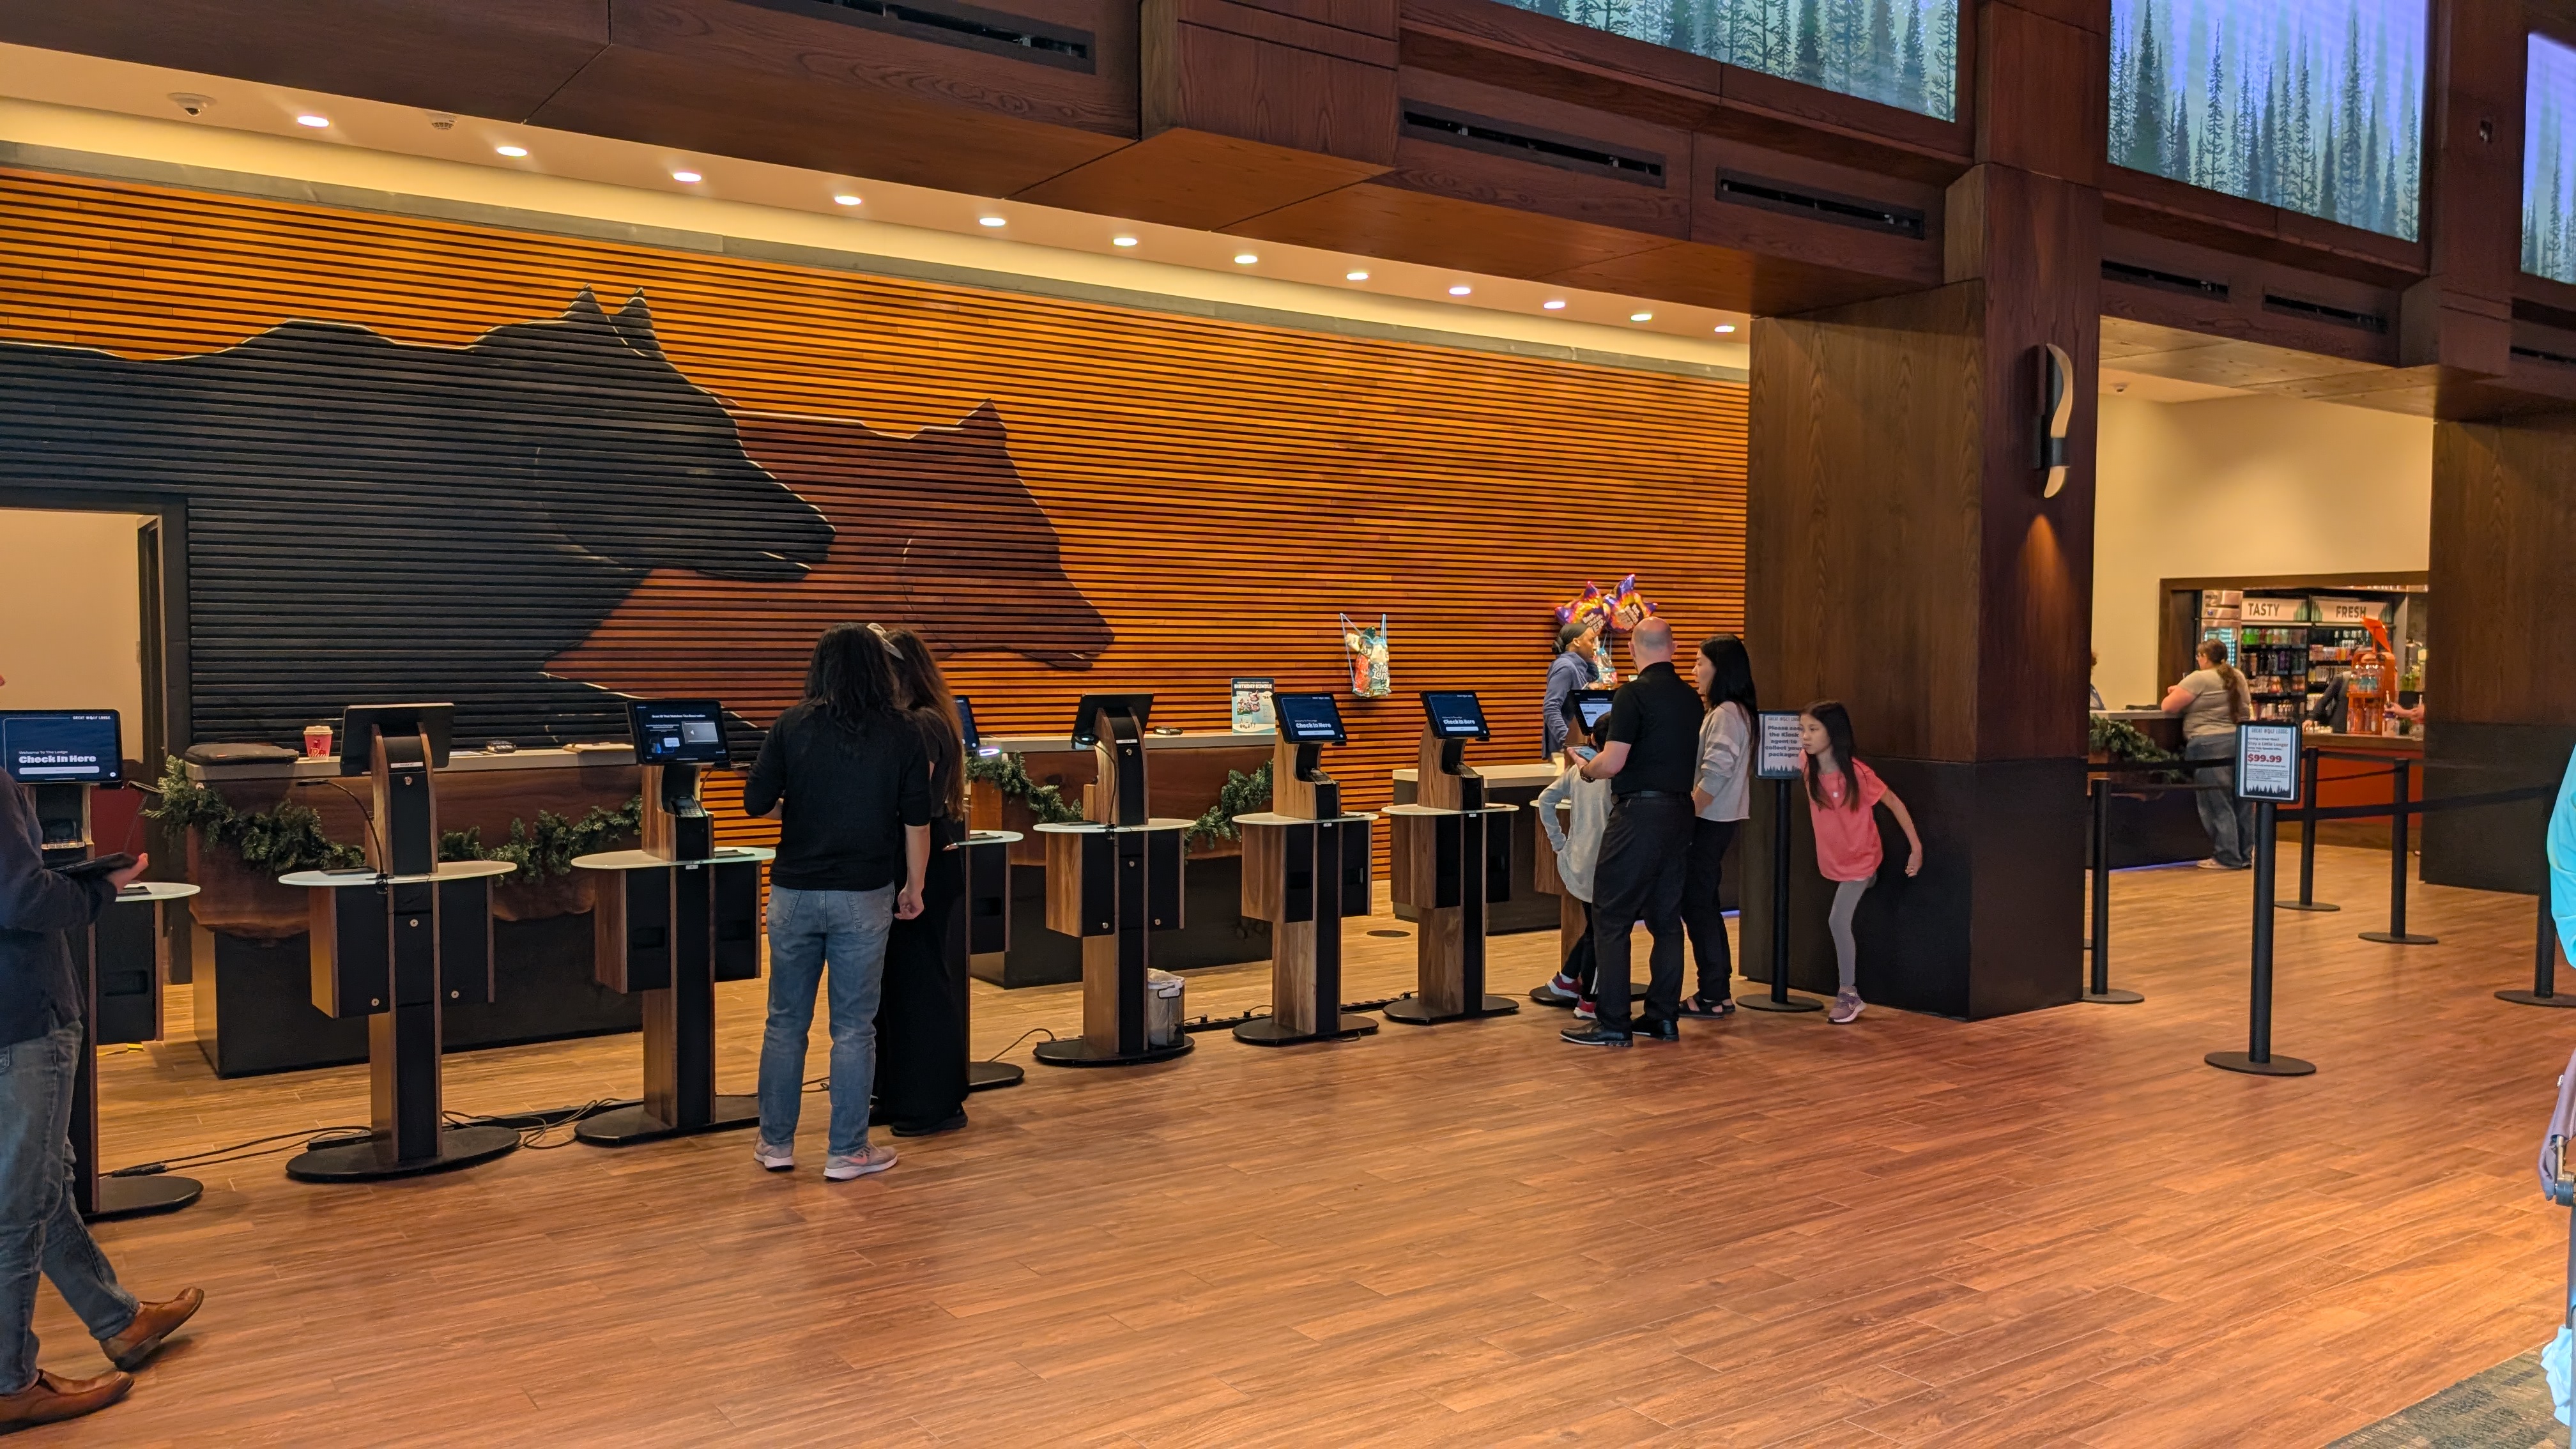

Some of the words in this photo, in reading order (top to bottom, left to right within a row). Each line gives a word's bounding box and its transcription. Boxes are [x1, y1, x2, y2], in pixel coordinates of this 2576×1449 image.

[2248, 603, 2280, 617] TASTY
[2336, 606, 2366, 618] FRESH
[19, 755, 56, 763] Check
[2248, 753, 2282, 763] $99.99
